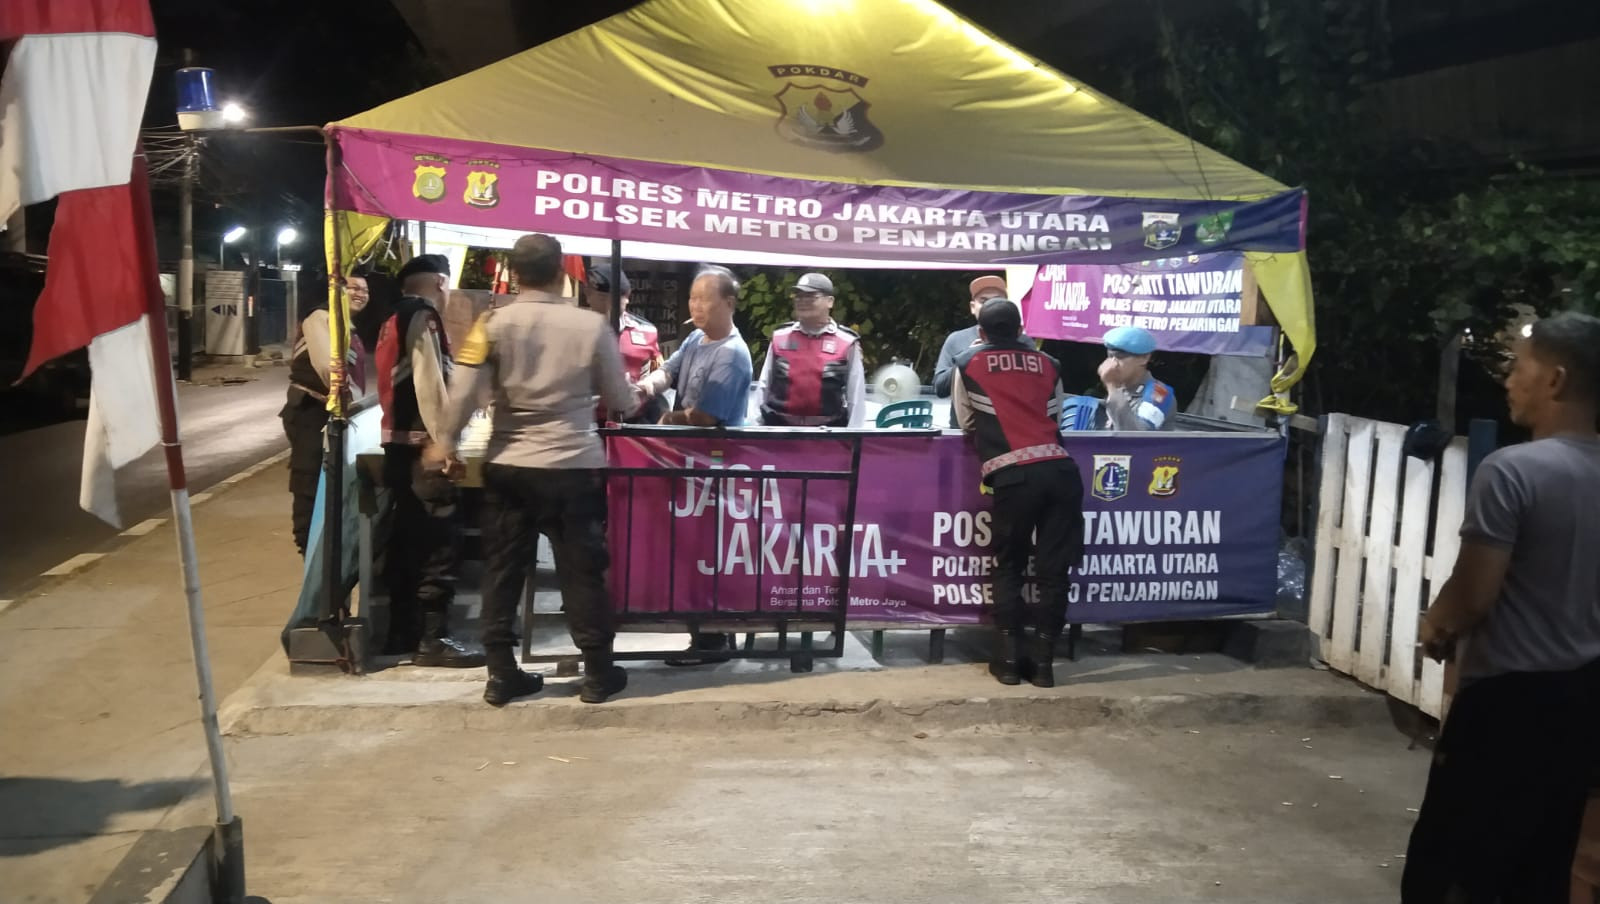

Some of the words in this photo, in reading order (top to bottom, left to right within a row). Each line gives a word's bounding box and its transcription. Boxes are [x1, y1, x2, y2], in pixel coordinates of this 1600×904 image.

[776, 66, 860, 83] POKDAR
[536, 170, 682, 204] POLRES
[697, 188, 822, 219] METRO
[833, 203, 989, 228] JAKARTA
[1001, 211, 1110, 233] UTARA
[535, 195, 690, 230] POLSEK
[704, 214, 838, 242] METRO
[853, 226, 1112, 252] PENJARINGAN
[1103, 273, 1131, 294] POS
[1166, 269, 1243, 295] TAWURAN
[223, 304, 238, 316] IN
[1100, 298, 1131, 312] POLRES
[1132, 299, 1167, 314] METRO
[1168, 299, 1207, 314] JAKARTA
[1207, 299, 1241, 314] UTARA
[1099, 313, 1132, 327] POLSEK
[1133, 315, 1167, 330] METRO
[1168, 316, 1240, 332] PENJARINGAN
[987, 353, 1043, 374] POLISI
[669, 456, 783, 520] JAGA
[933, 511, 992, 547] POS
[1082, 511, 1222, 545] TAWURAN
[1078, 554, 1157, 576] JAKARTA
[1162, 553, 1219, 575] UTARA
[802, 586, 821, 595] dan
[932, 583, 994, 605] POLSE
[1086, 580, 1219, 603] PENJARINGAN
[850, 596, 880, 607] Metro
[881, 598, 907, 609] Jaya
